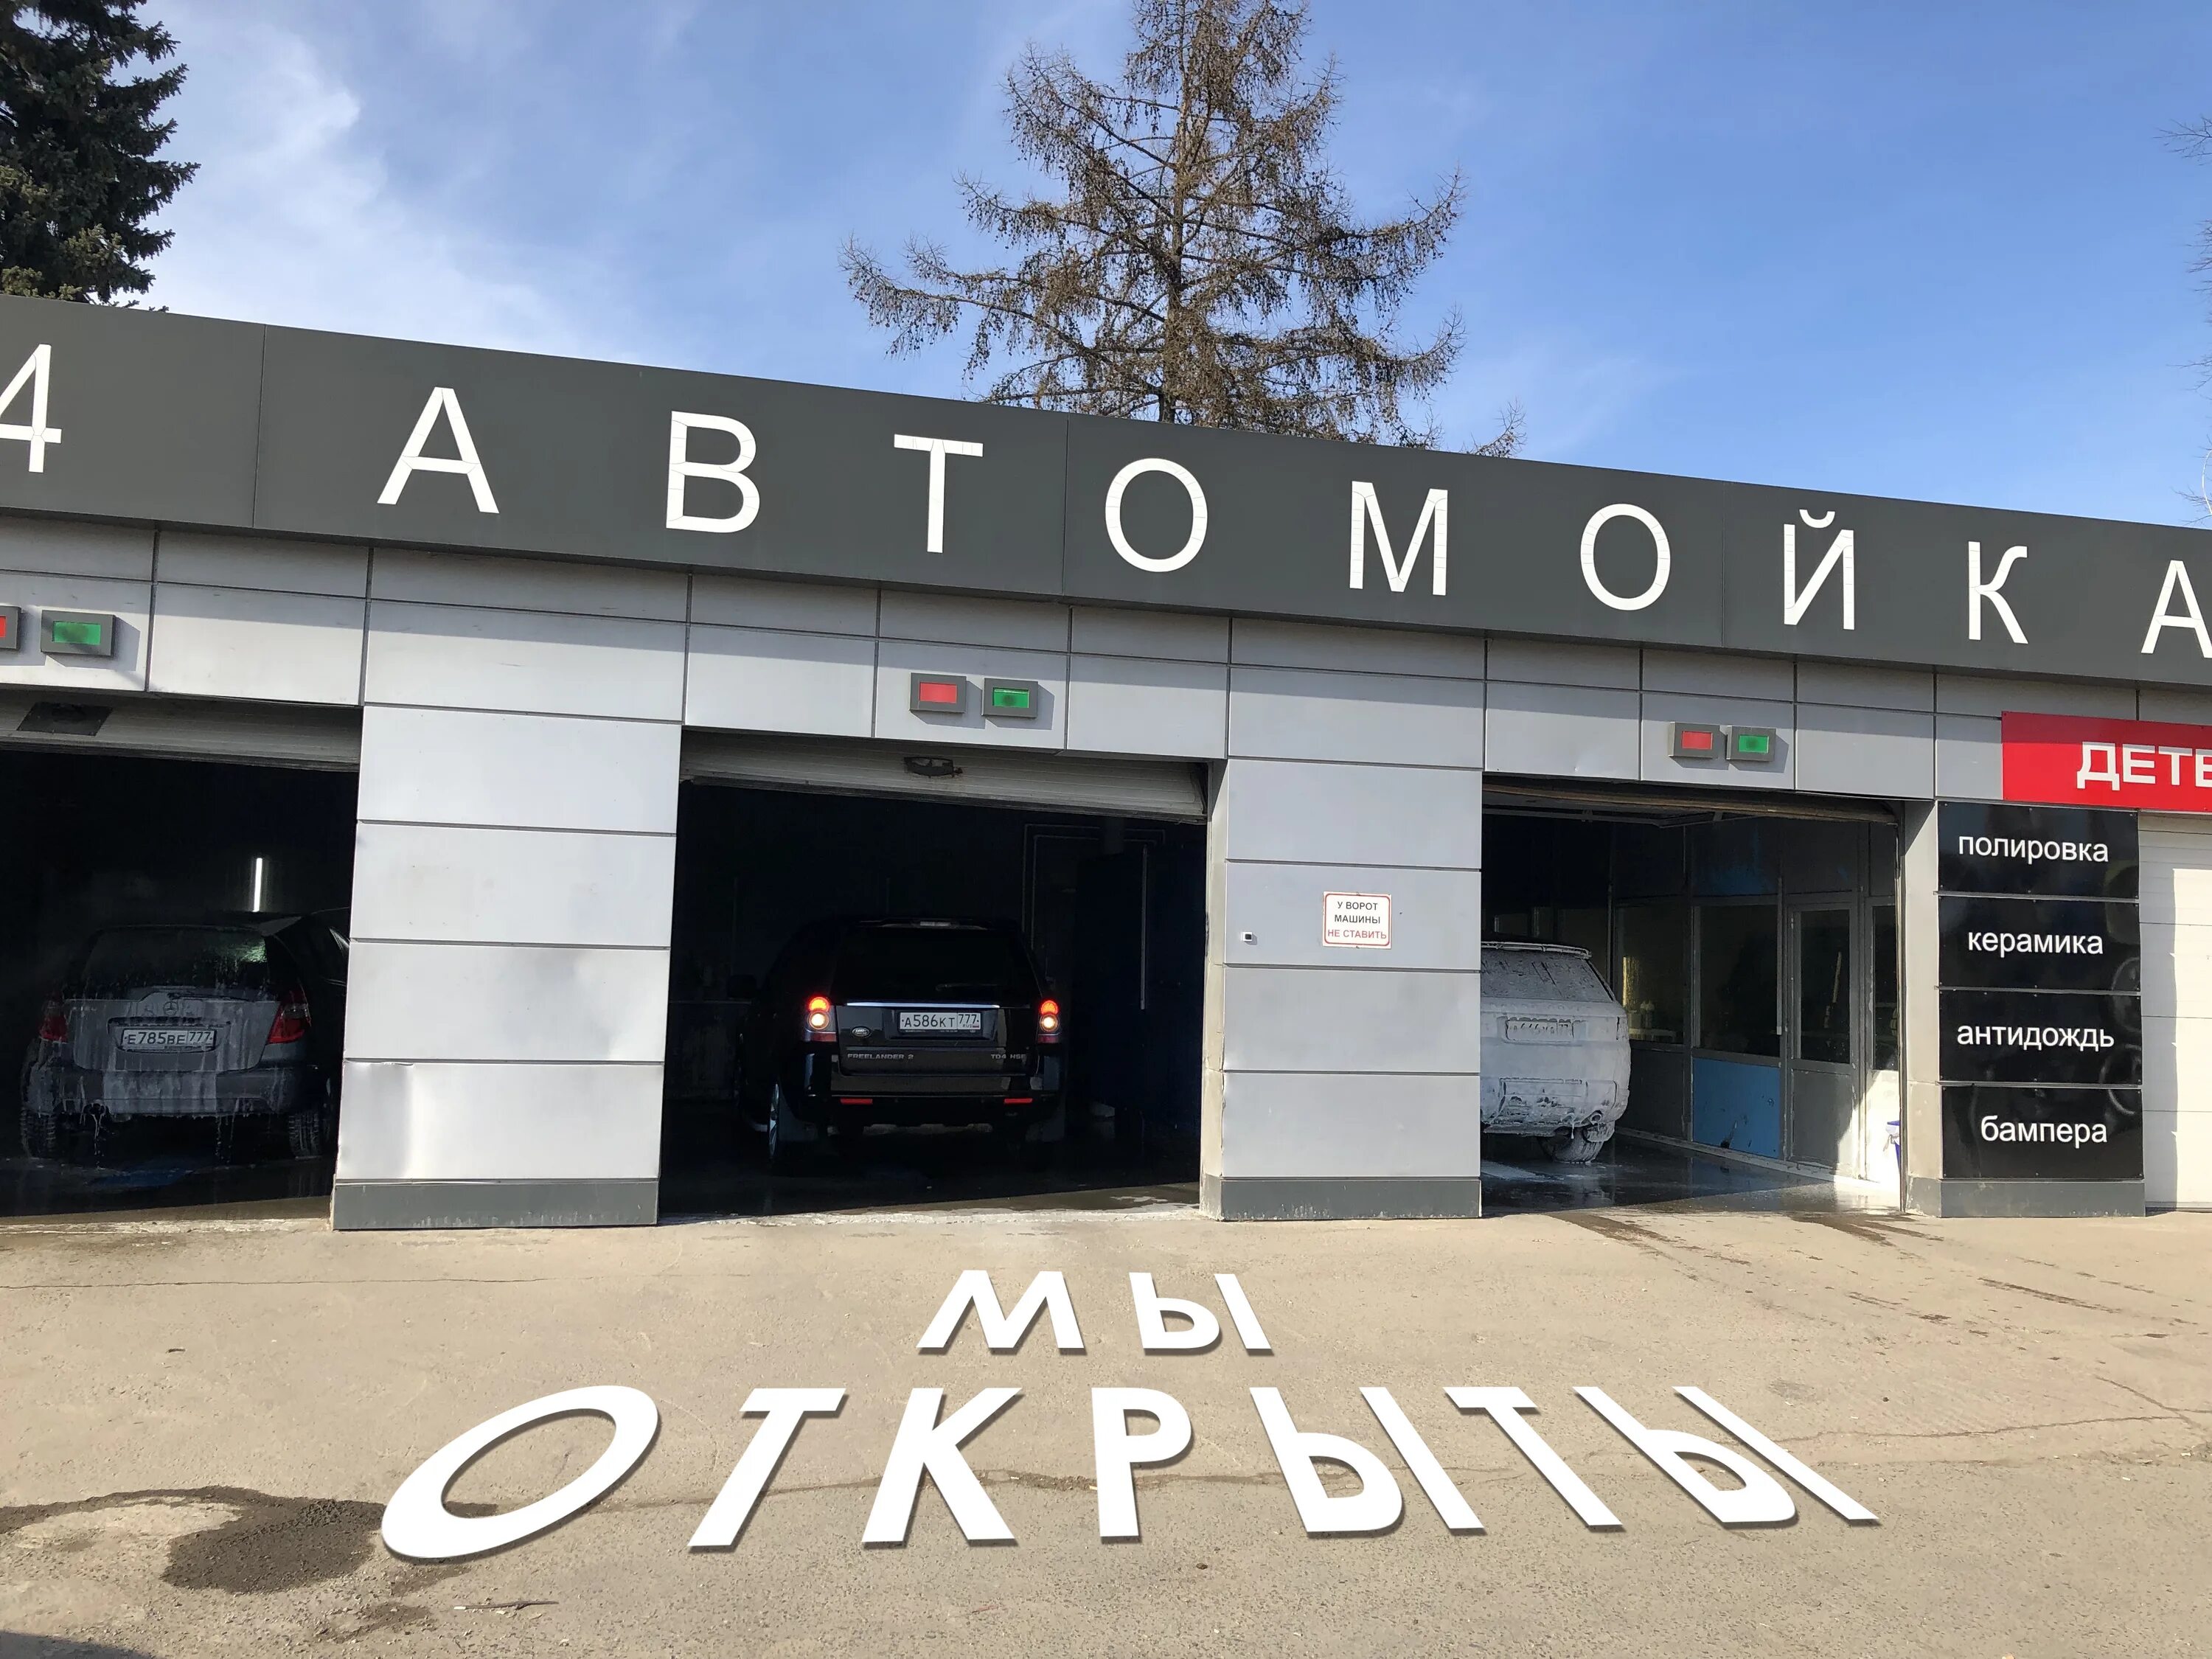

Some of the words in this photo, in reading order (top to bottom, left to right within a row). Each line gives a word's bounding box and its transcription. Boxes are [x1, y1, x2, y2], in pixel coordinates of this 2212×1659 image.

[377, 386, 2212, 658] АВТОМОЙКА
[1958, 834, 2110, 865] полировка
[1334, 914, 1380, 924] МАШИНЫ
[1337, 900, 1343, 909] У
[1346, 901, 1378, 911] ВОРОТ
[1327, 929, 1340, 937] НЕ
[1343, 929, 1387, 939] СТАВИТЬ
[1968, 930, 2104, 958] керамика
[1957, 1023, 2115, 1050] антидождь
[1980, 1114, 2108, 1145] бампера
